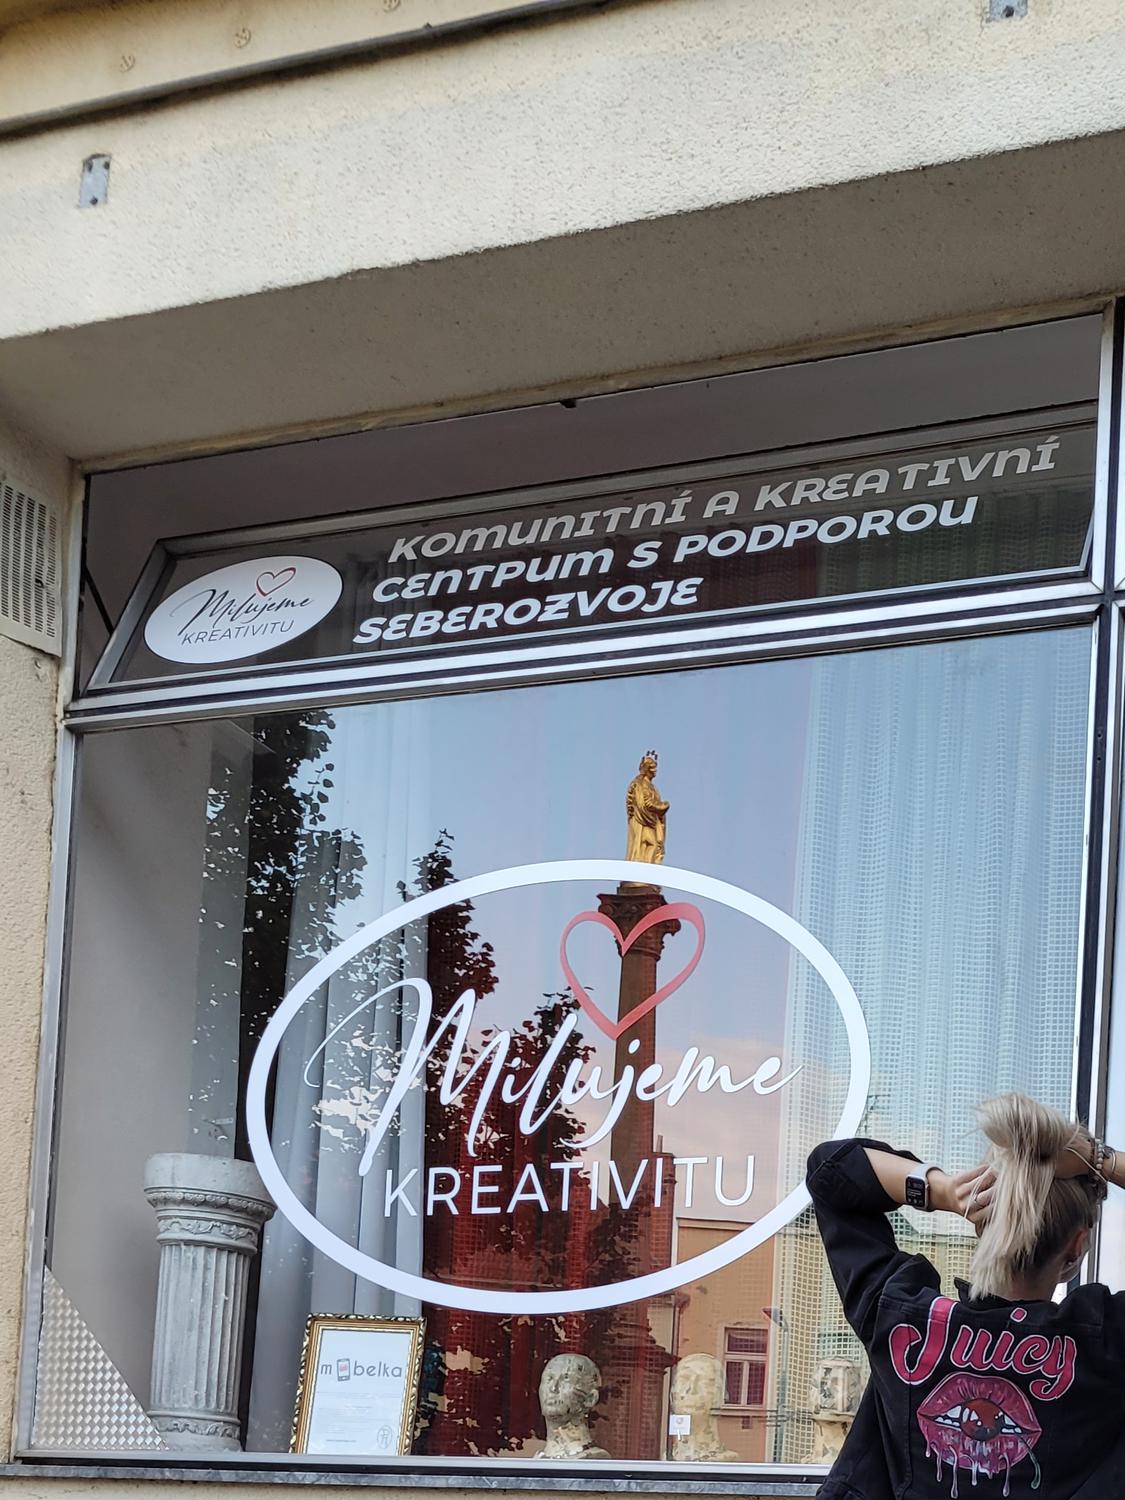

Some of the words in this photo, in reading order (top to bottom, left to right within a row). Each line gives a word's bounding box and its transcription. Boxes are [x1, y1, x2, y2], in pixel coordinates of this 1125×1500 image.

[627, 540, 663, 568] S
[673, 495, 979, 563] PODPOROU
[702, 490, 739, 519] A
[169, 588, 313, 637] Milujeme
[181, 619, 295, 646] KREATIVITU
[352, 576, 704, 644] SEBEROZVOJE
[304, 977, 802, 1177] Milujeme
[382, 1154, 755, 1219] KREATIVITU
[888, 1295, 1078, 1402] Juicy
